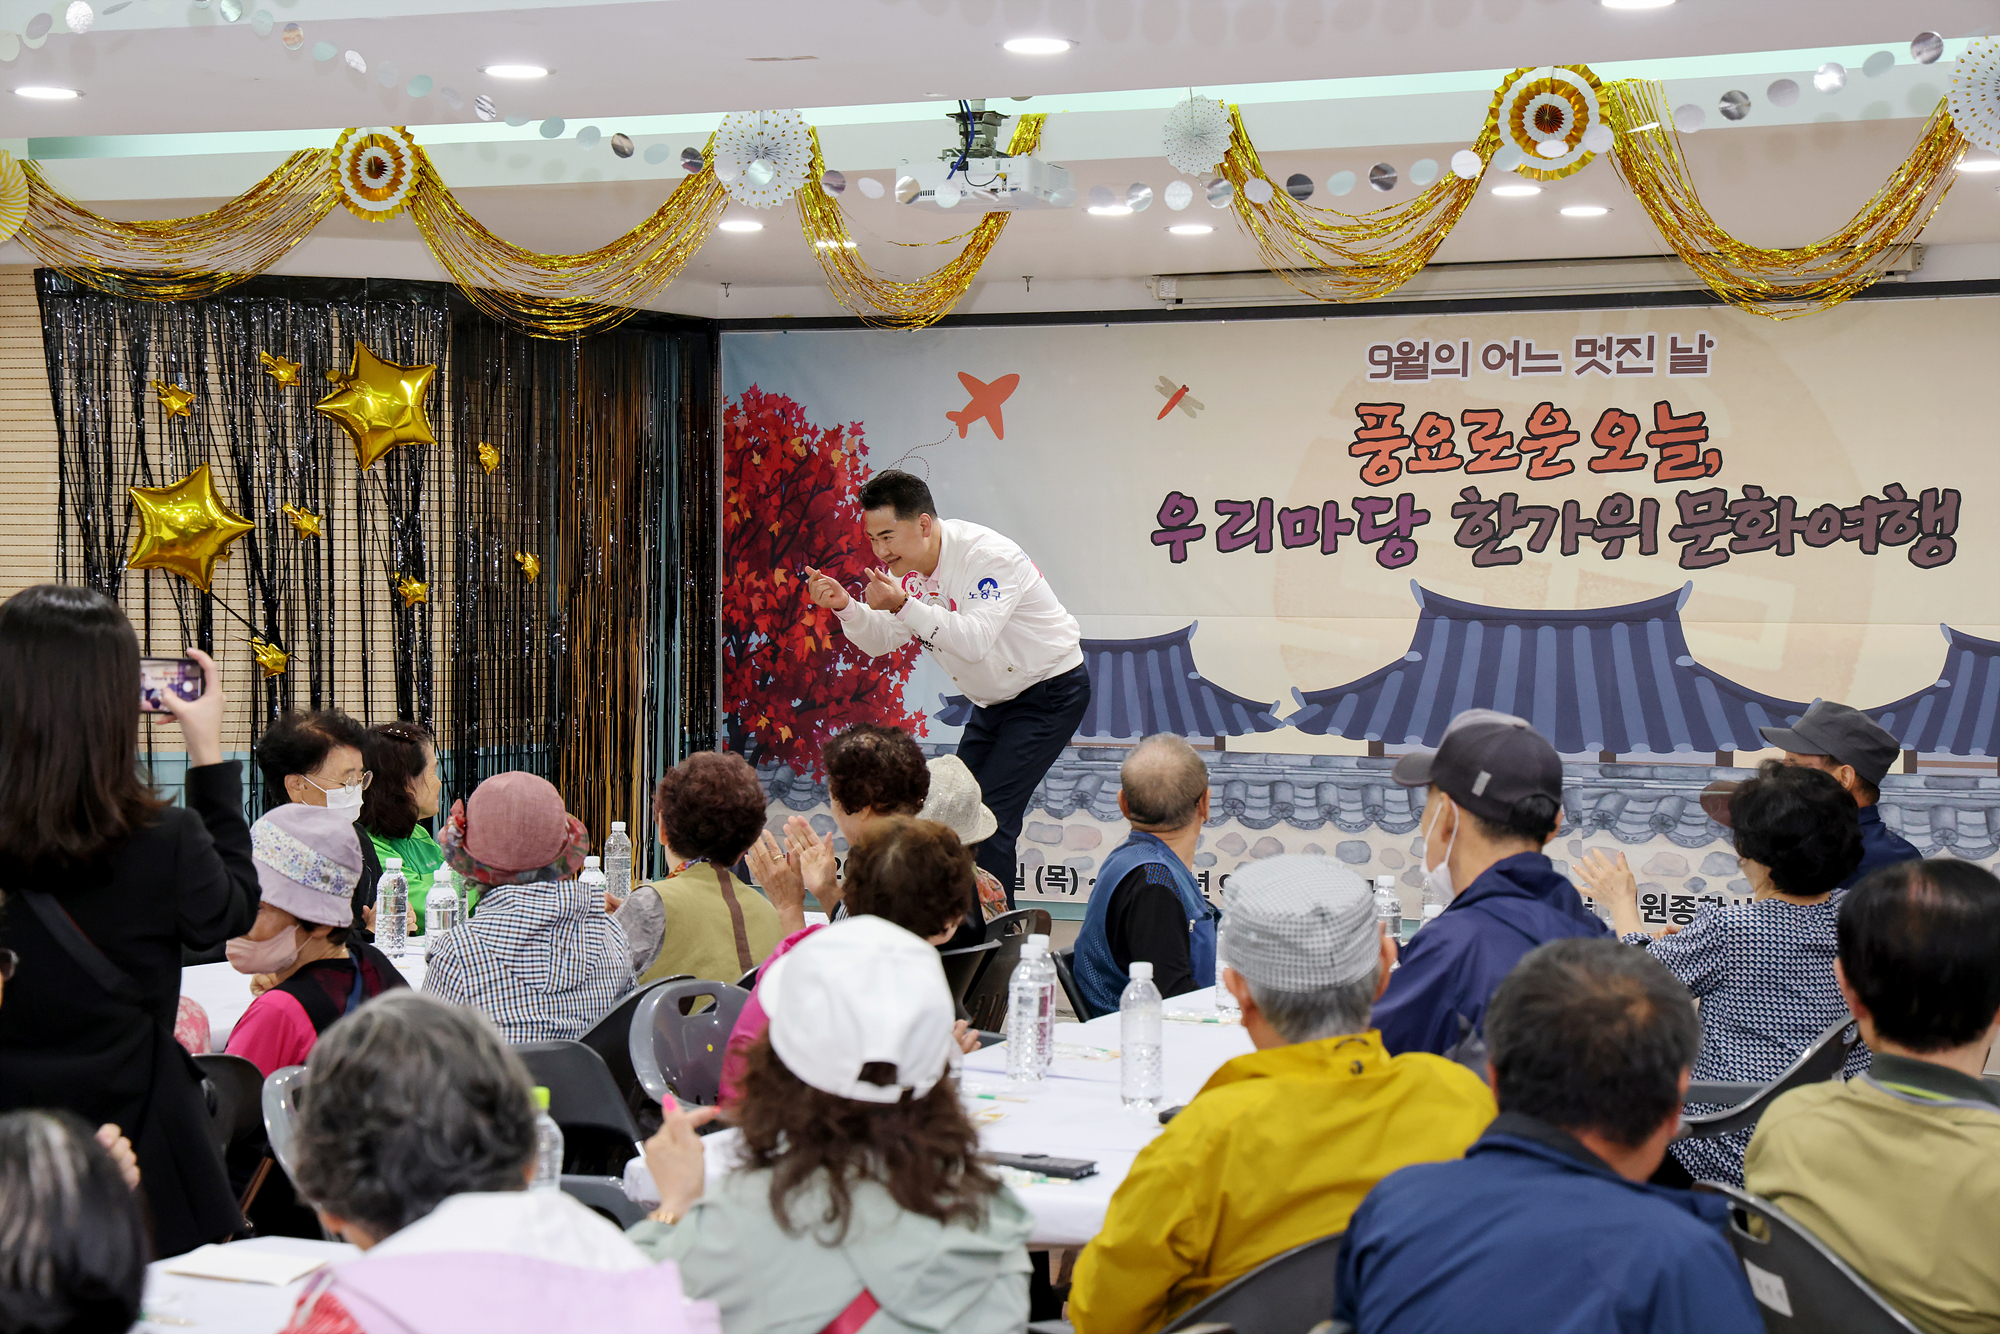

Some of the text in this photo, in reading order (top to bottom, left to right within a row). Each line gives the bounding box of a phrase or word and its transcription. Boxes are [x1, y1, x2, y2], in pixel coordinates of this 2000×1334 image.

[1367, 334, 1715, 381] 9월의 어느 멋진 날
[1350, 400, 1723, 487] 풍요로운 오늘,
[1151, 482, 1962, 570] 우리마당 한가위 문화여행
